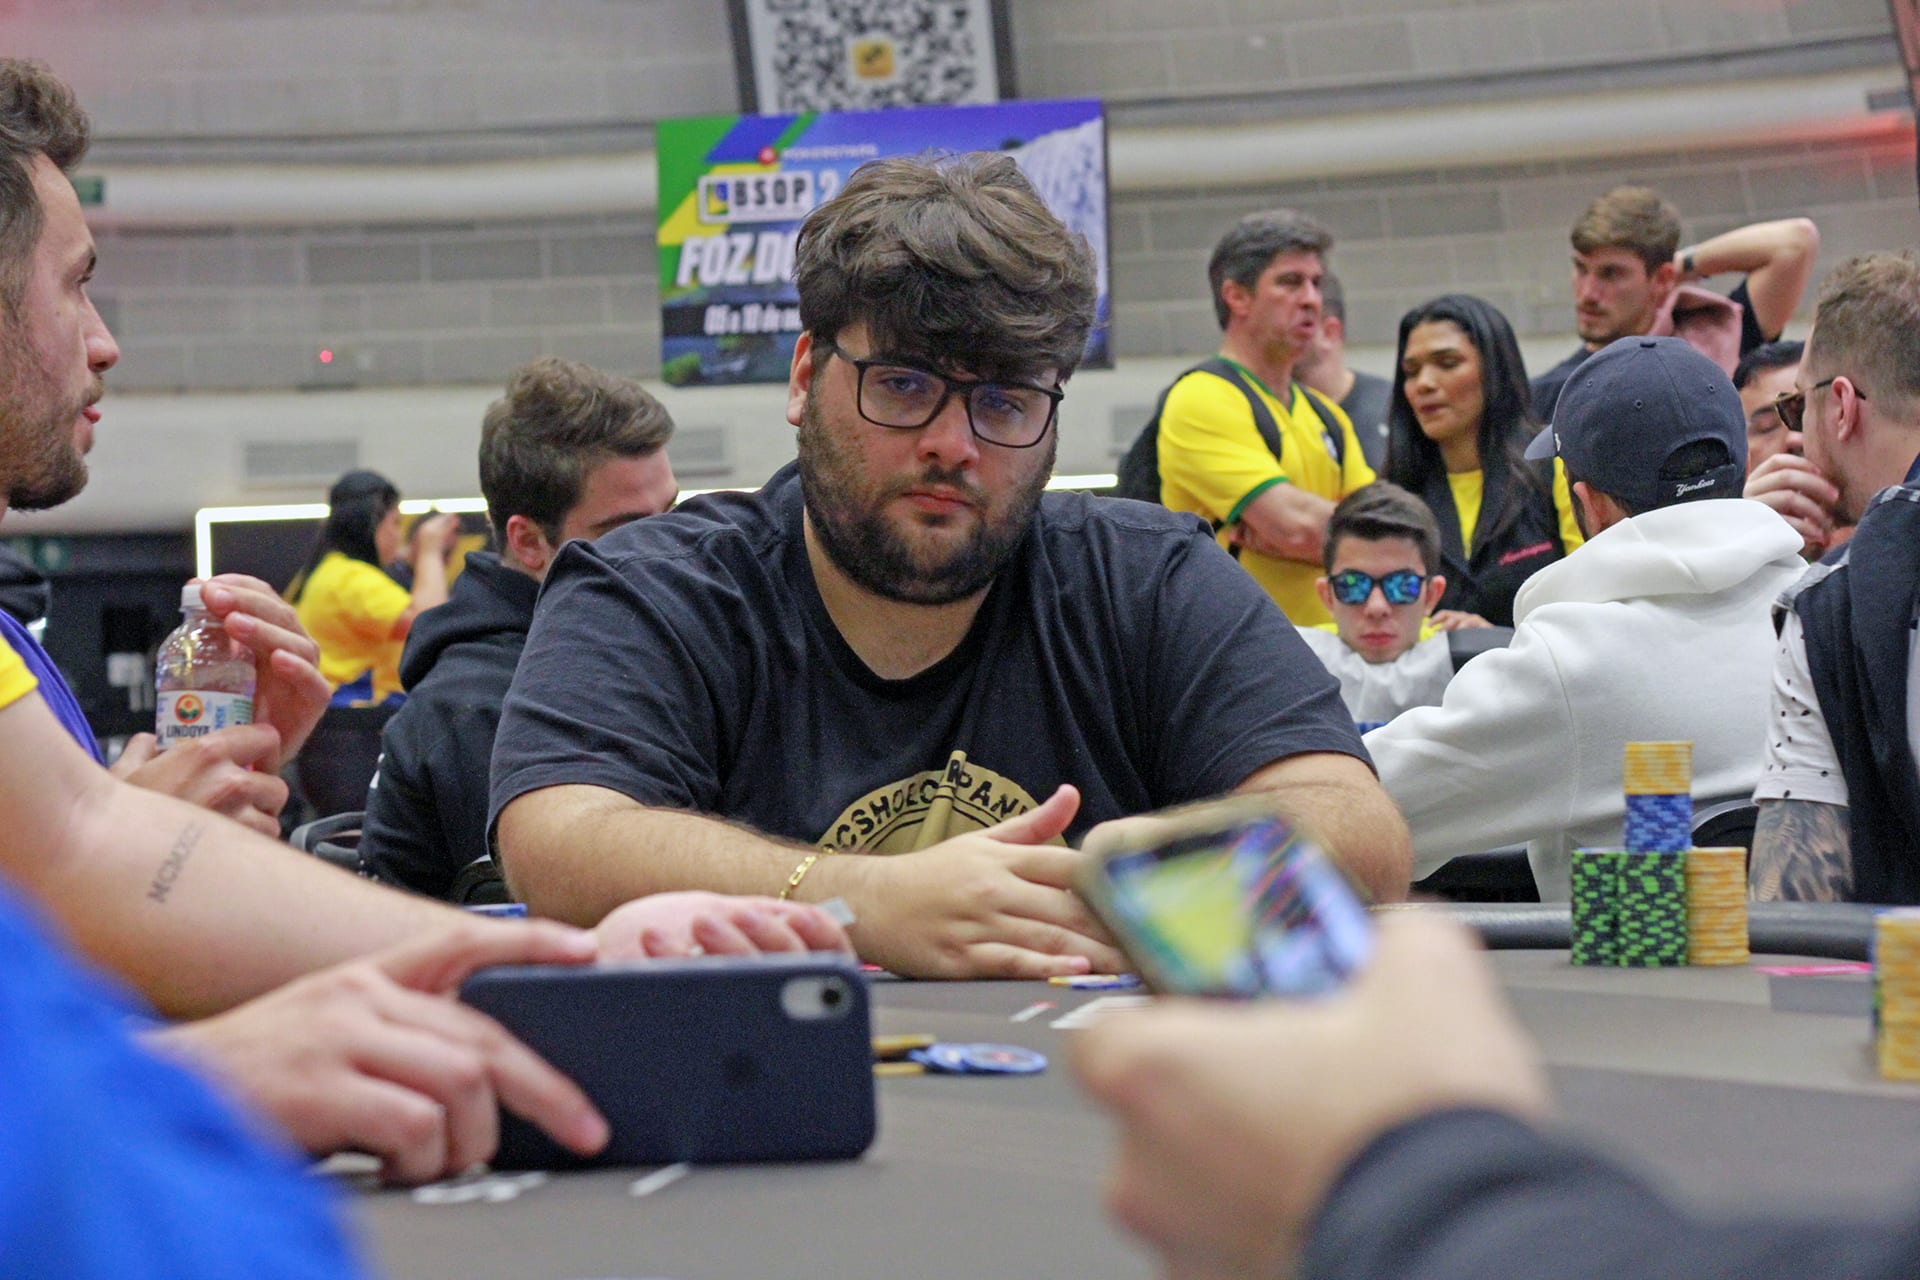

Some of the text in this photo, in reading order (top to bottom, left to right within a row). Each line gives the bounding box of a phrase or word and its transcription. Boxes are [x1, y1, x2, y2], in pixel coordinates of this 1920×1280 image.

[734, 177, 806, 207] BSOP
[676, 232, 755, 286] FOZ
[1675, 478, 1716, 497] Yankees
